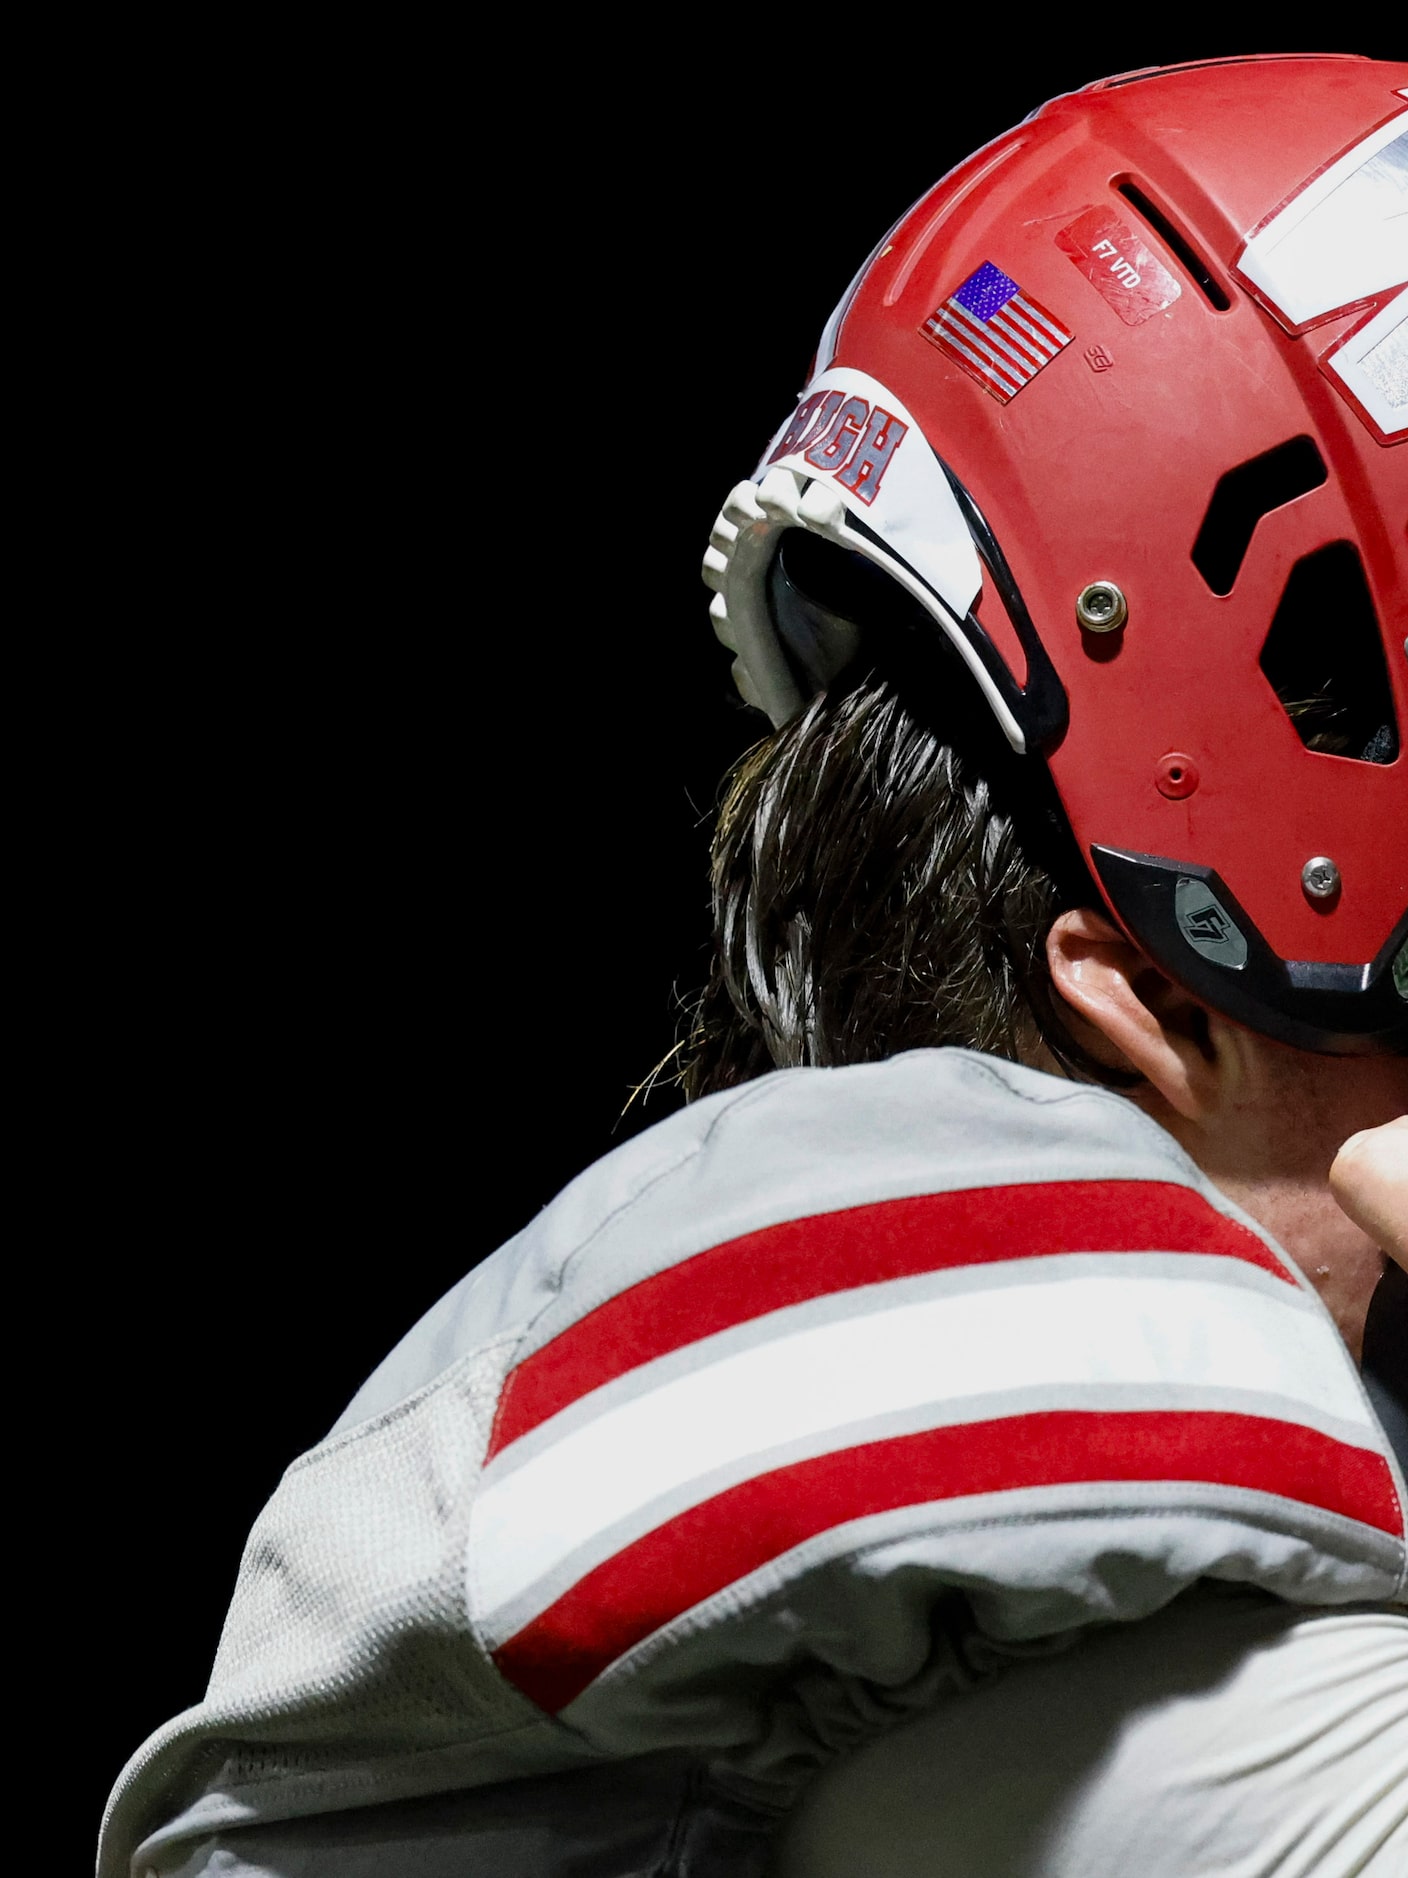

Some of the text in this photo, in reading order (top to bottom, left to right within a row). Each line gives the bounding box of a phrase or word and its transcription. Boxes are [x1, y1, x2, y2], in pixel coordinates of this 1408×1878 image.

[1091, 239, 1141, 288] F7 VTD
[766, 389, 909, 507] HIGH
